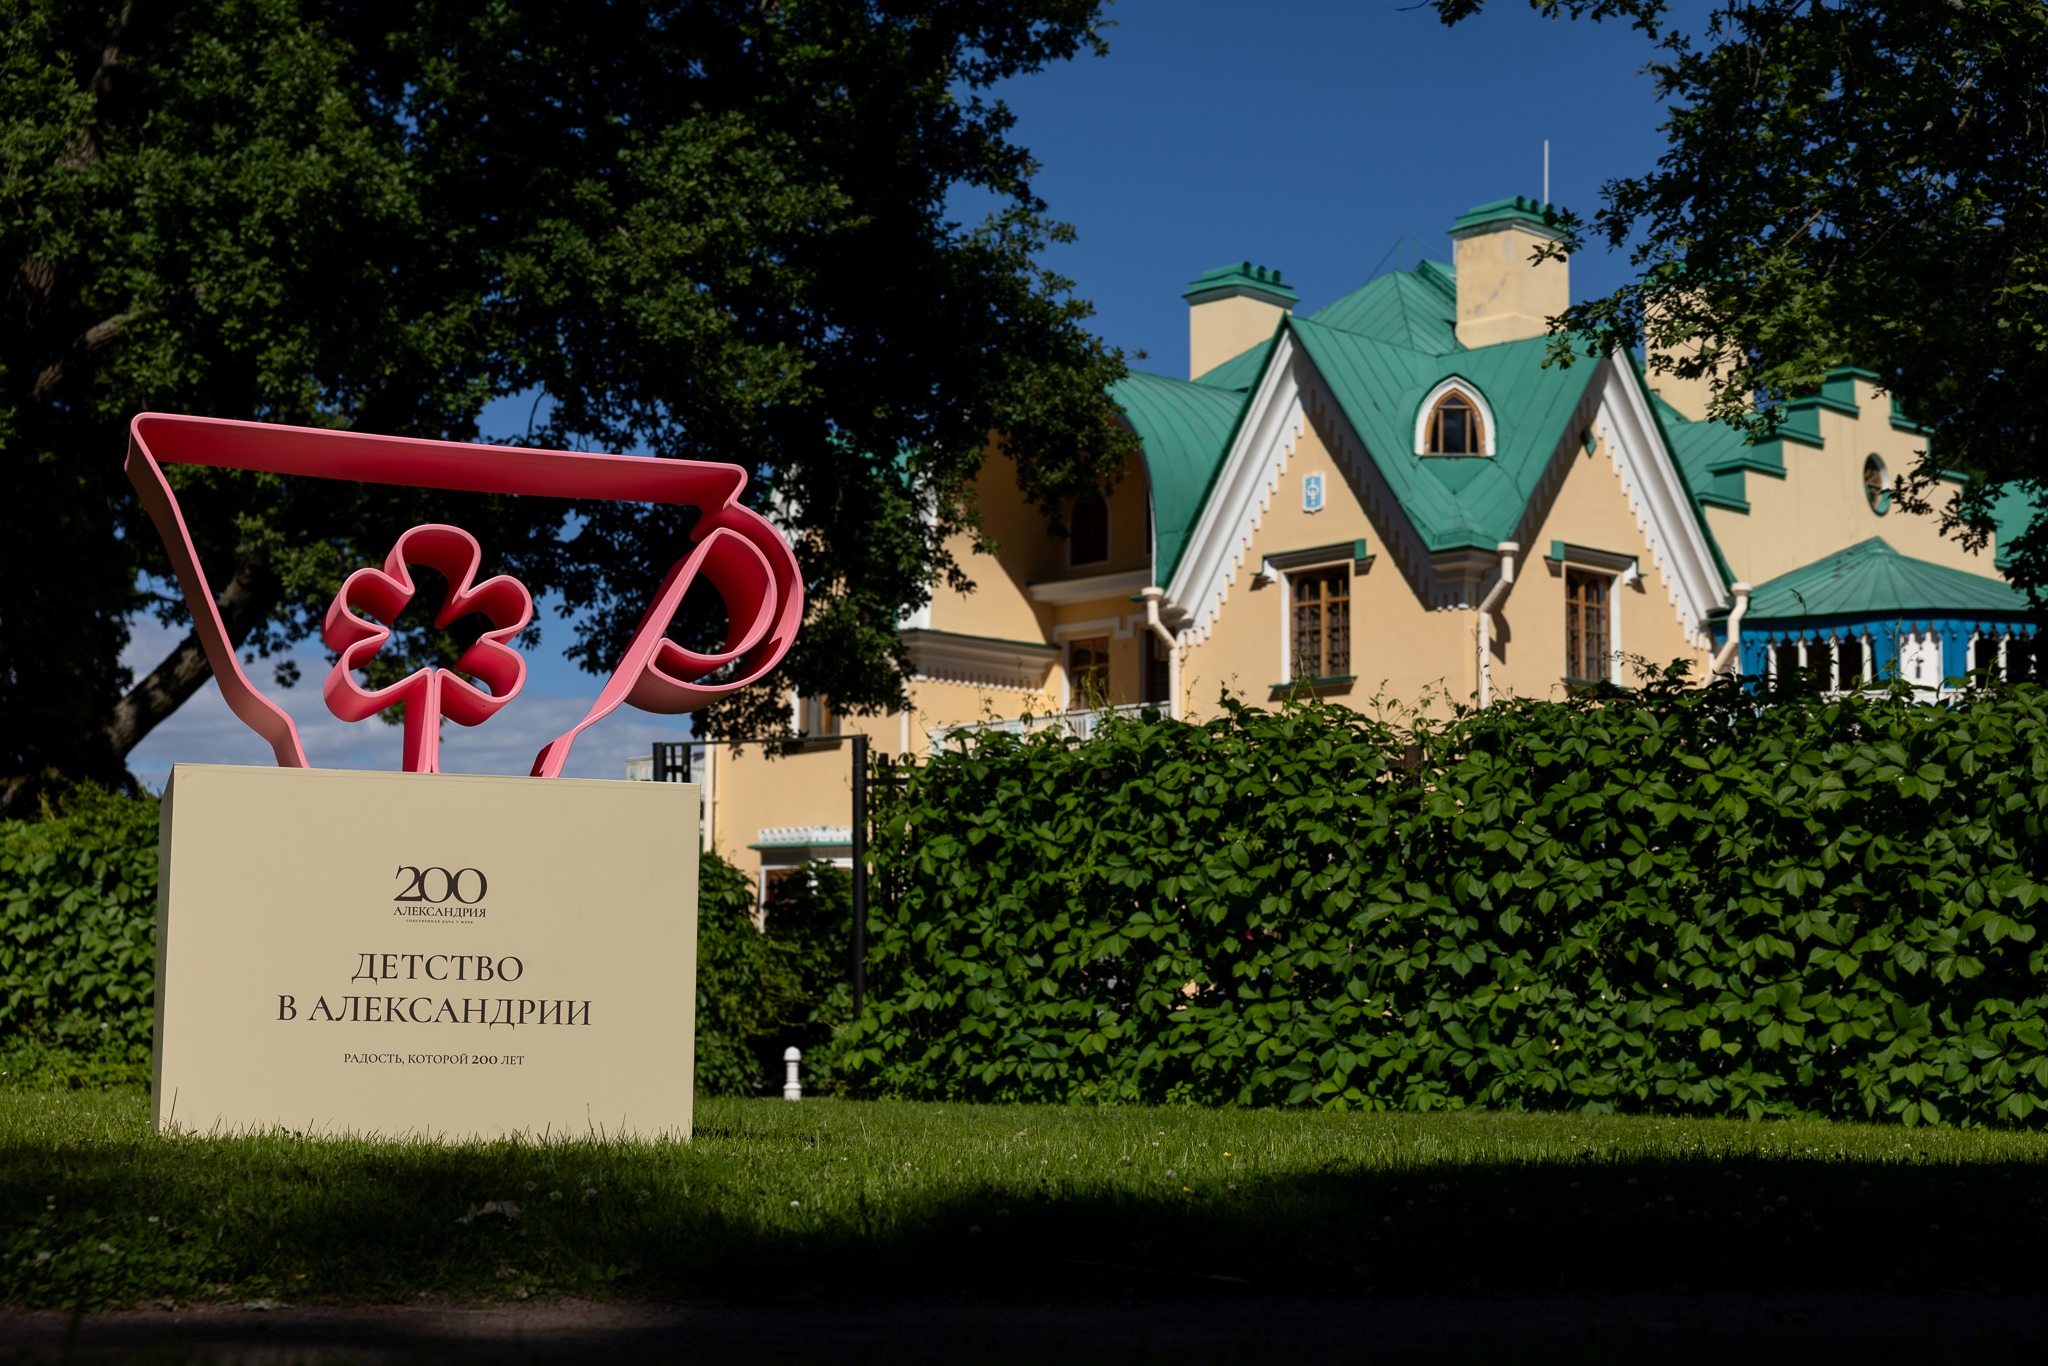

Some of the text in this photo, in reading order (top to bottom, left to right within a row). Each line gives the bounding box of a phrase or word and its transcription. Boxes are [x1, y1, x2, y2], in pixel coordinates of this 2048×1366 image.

[394, 865, 487, 905] 200
[393, 906, 487, 918] АЛЕКСАНДРИЯ
[351, 953, 524, 985] ДЕТСТВО
[277, 995, 592, 1030] В АЛЕКСАНДРИИ
[343, 1052, 525, 1065] РАДОСТЬ, КОТОРОЙ 200 ЛЕТ
